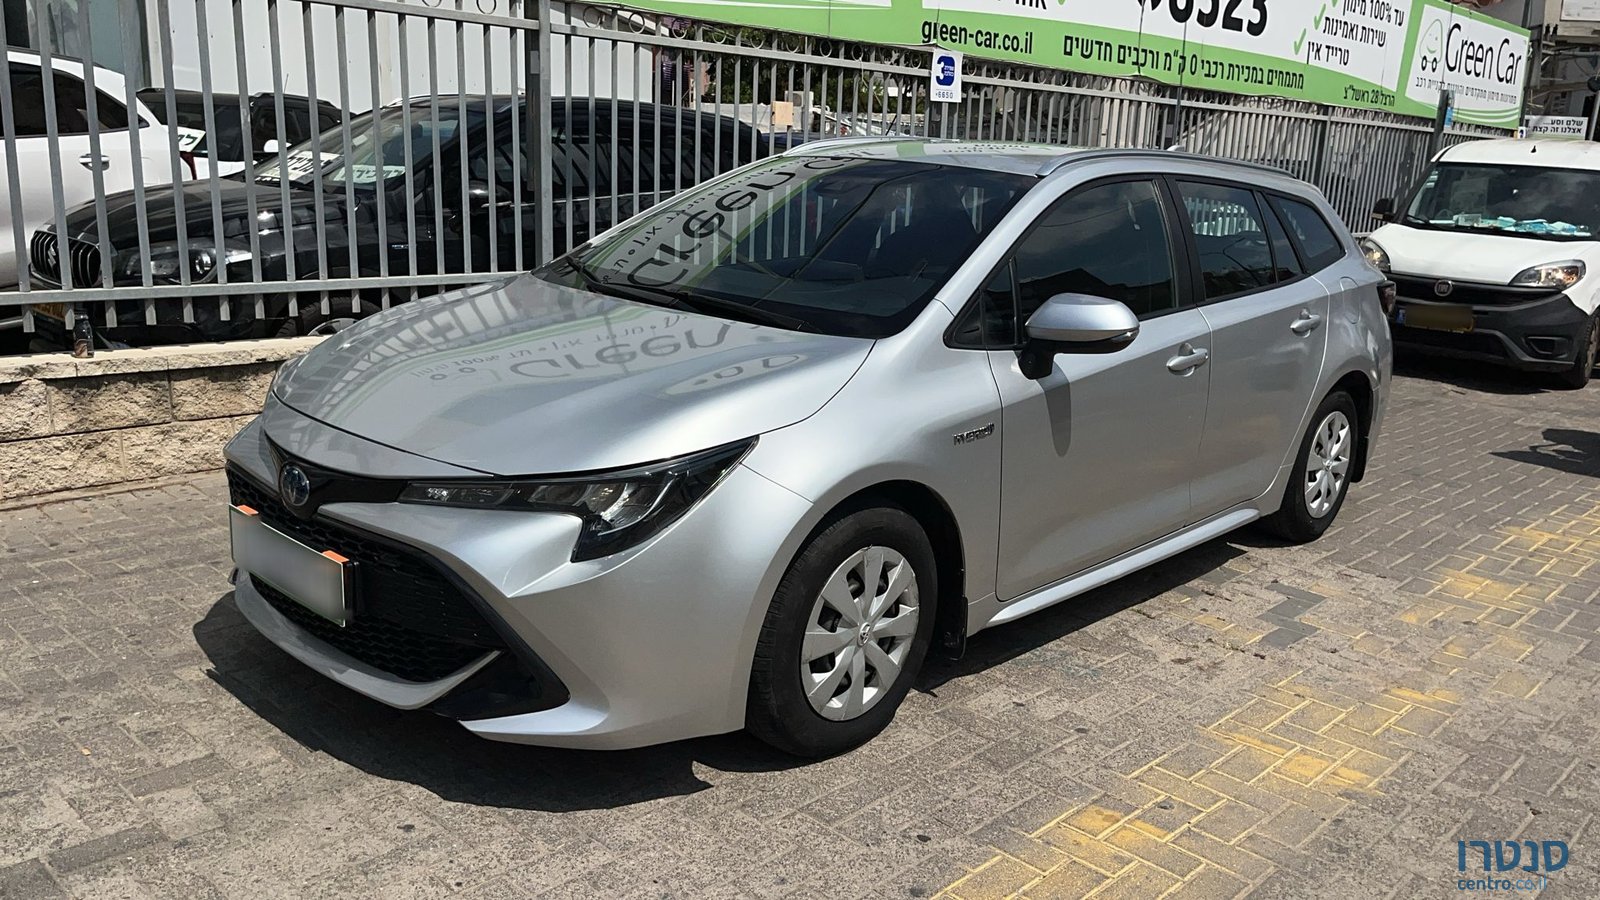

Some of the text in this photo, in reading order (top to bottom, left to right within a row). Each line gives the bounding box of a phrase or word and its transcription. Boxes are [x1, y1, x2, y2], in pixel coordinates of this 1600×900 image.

[1370, 0, 1392, 23] 100%
[1394, 8, 1405, 27] עד
[921, 20, 1033, 54] green-car.co.il
[1322, 16, 1387, 47] שירות ואמינות
[1063, 35, 1113, 62] חדשים
[1116, 44, 1160, 69] ורכבים
[1306, 41, 1350, 66] טרייד אין
[1445, 23, 1522, 85] Green Car
[1189, 53, 1198, 76] 0
[1201, 59, 1225, 79] רכבי
[1226, 62, 1264, 85] במכירת
[1266, 68, 1304, 90] מתמחים
[1370, 89, 1380, 104] 28
